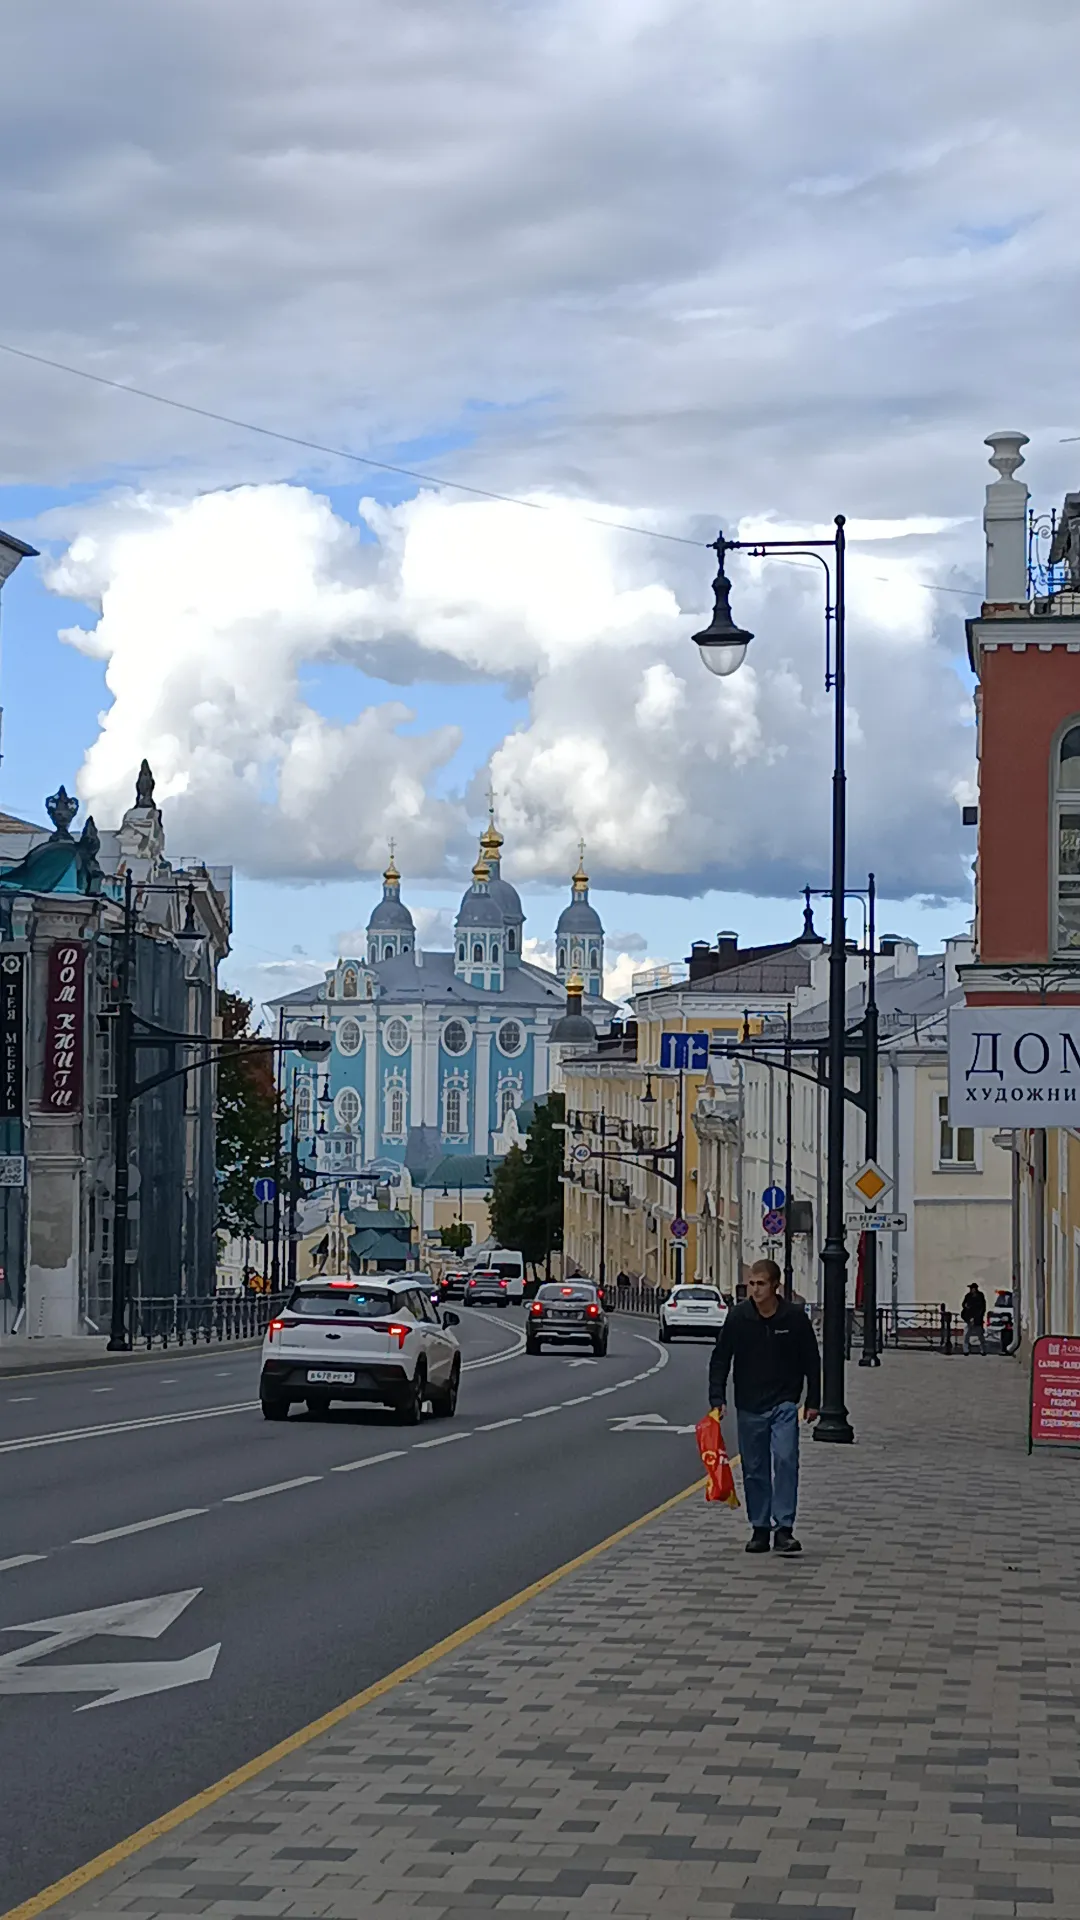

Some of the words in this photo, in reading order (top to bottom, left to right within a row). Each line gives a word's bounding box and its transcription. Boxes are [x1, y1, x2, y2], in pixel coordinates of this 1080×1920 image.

[54, 948, 78, 1002] ДОМ
[5, 1032, 17, 1110] МЕБЕЛЬ
[50, 1013, 76, 1106] КНИГИ
[576, 1149, 588, 1158] 40
